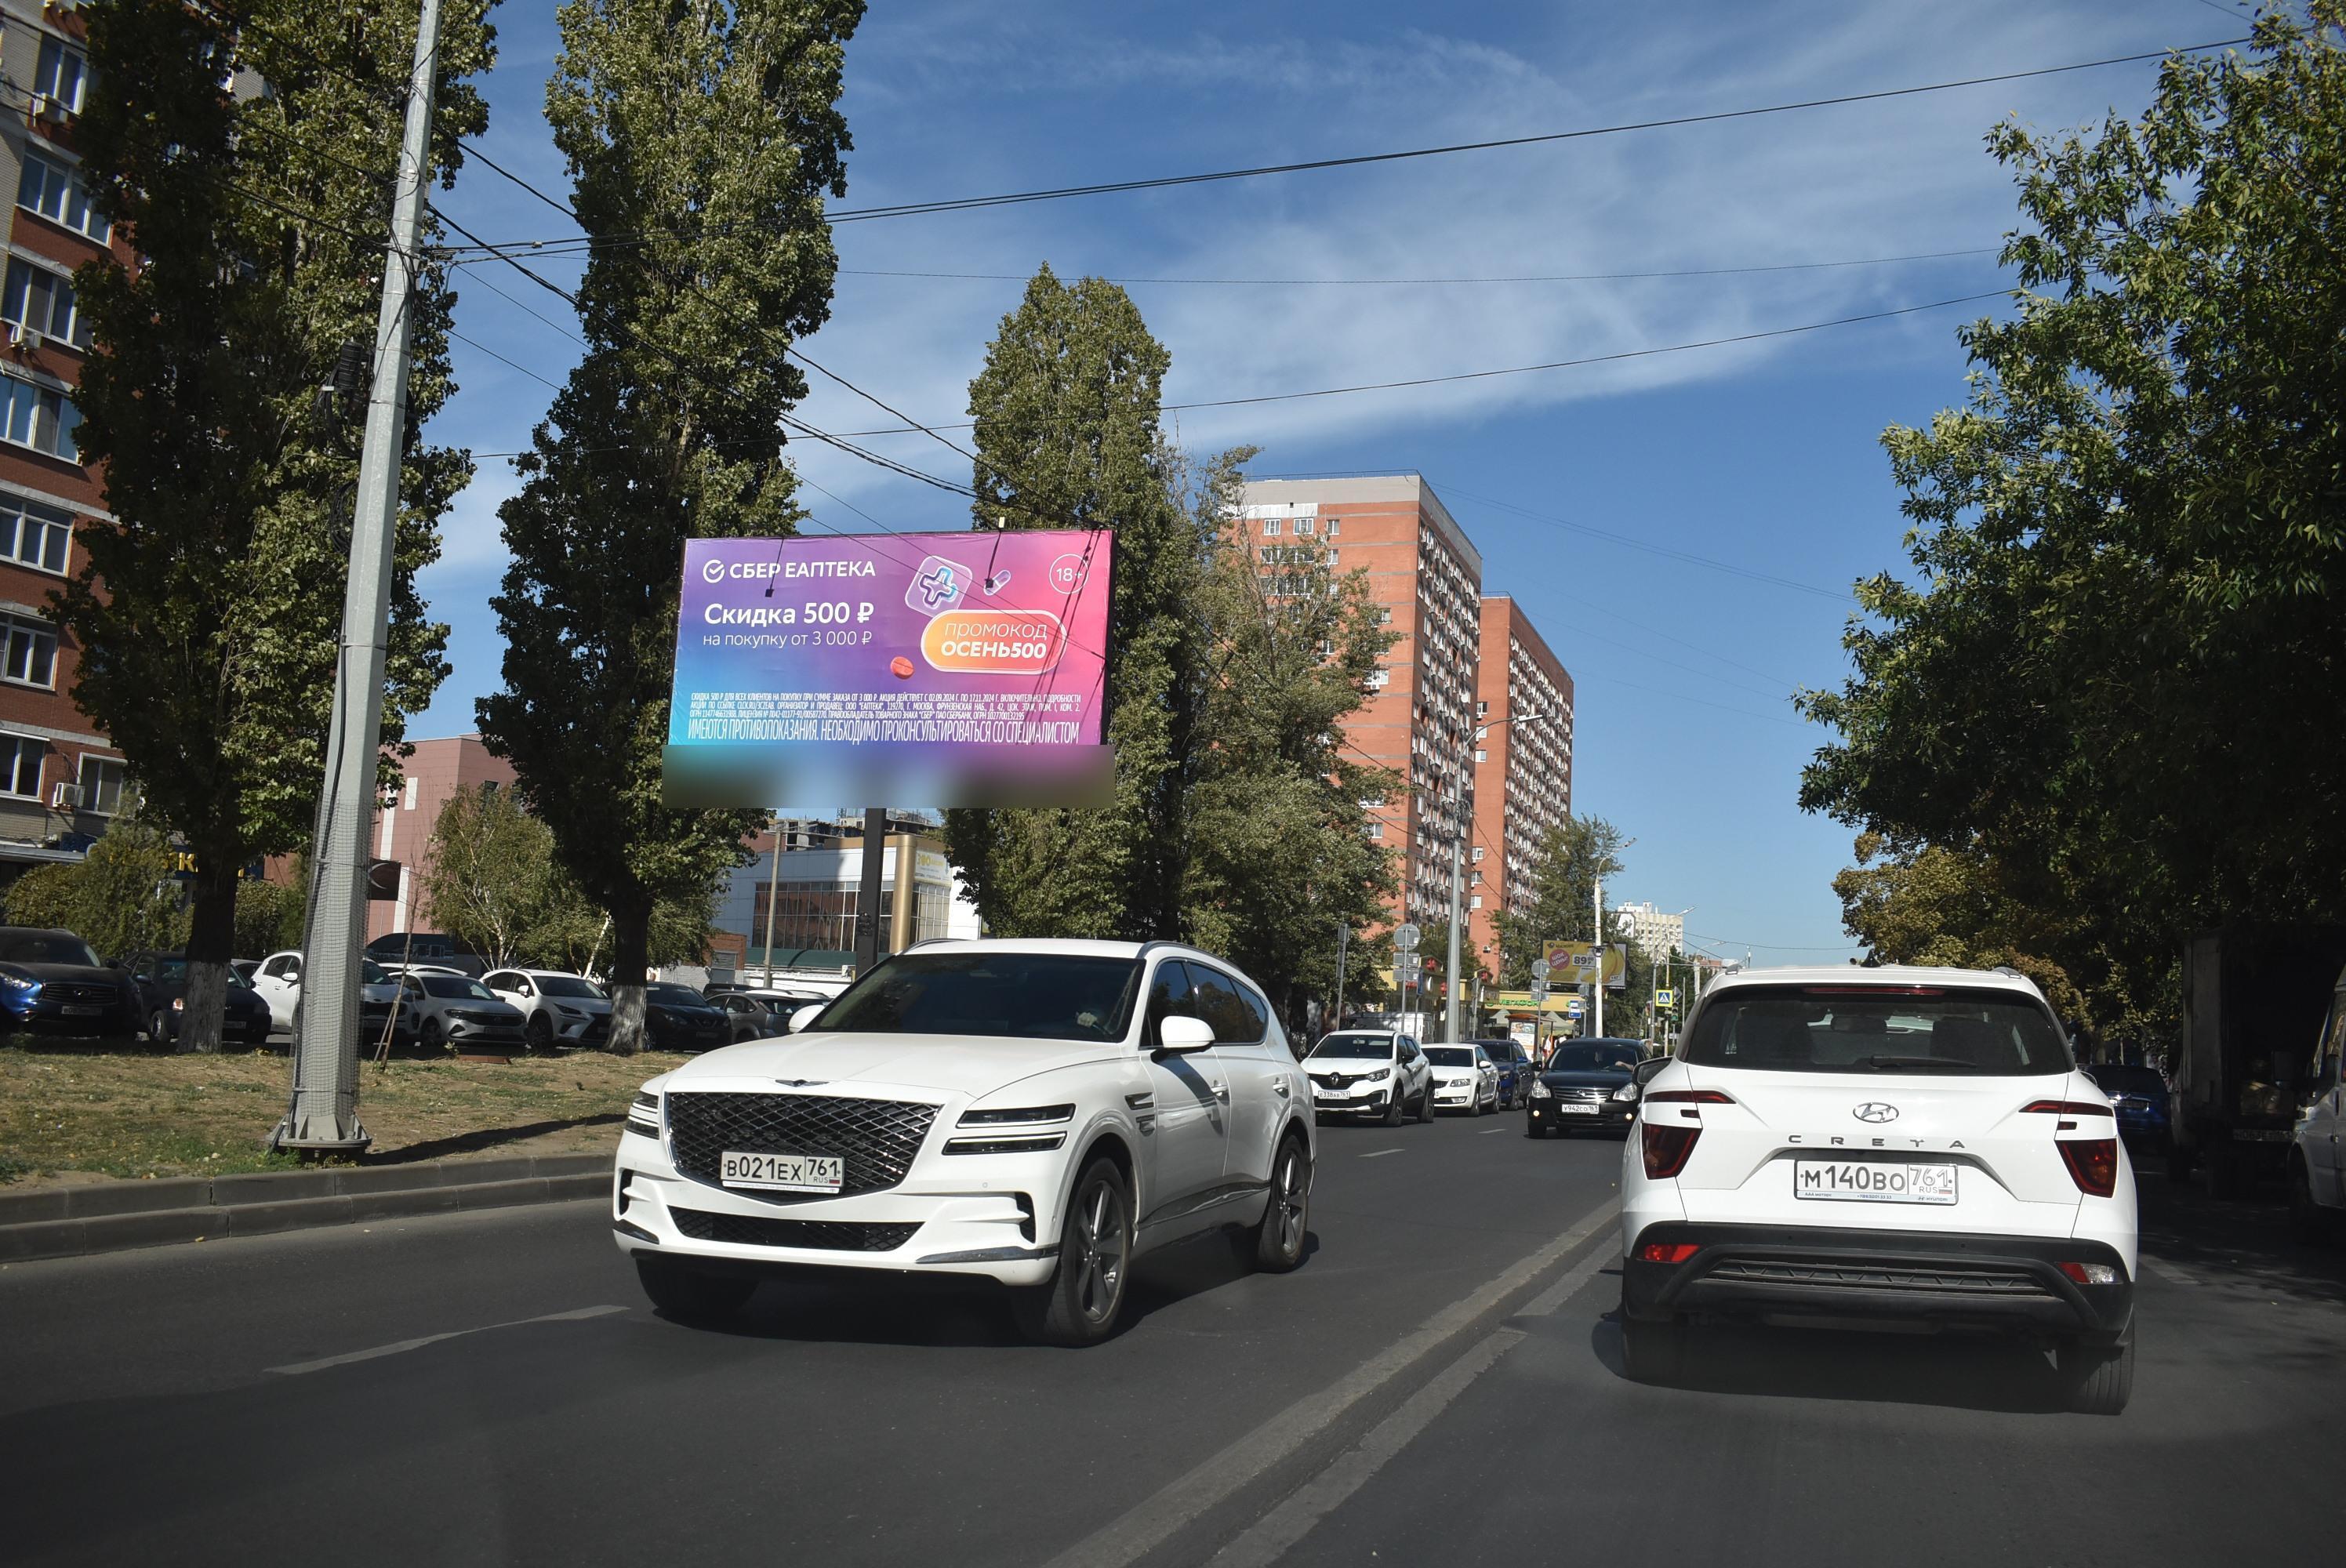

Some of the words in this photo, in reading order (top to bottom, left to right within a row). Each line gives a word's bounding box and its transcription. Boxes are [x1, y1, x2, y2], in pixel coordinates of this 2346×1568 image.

[730, 563, 781, 579] СБЕР
[785, 561, 876, 578] ЕАПТЕКА
[1056, 568, 1083, 581] 18+
[704, 603, 796, 627] Скидка
[804, 602, 850, 624] 500
[703, 634, 721, 646] на
[724, 634, 787, 648] покупку
[791, 634, 808, 646] от
[812, 630, 822, 645] 3
[826, 630, 857, 645] 000
[941, 641, 1047, 659] ОСЕНЬ500
[688, 719, 728, 739] ИМЕЮТСЯ
[728, 719, 819, 740] ПРОТИВОПОКАЗАНИЯ.
[821, 720, 880, 745] НЕОБХОДИМО
[882, 720, 991, 742] ПРОКОНСУЛЬТИРОВАТЬСЯ
[993, 721, 1004, 743] СО
[1006, 721, 1080, 745] СПЕЦИАЛИСТОМ
[1574, 956, 1587, 964] 89
[1789, 1135, 1965, 1149] CRETA
[727, 1156, 802, 1181] В021ЕХ
[808, 1159, 837, 1177] 761
[1804, 1165, 1906, 1191] М140ВО
[1910, 1167, 1948, 1187] 761
